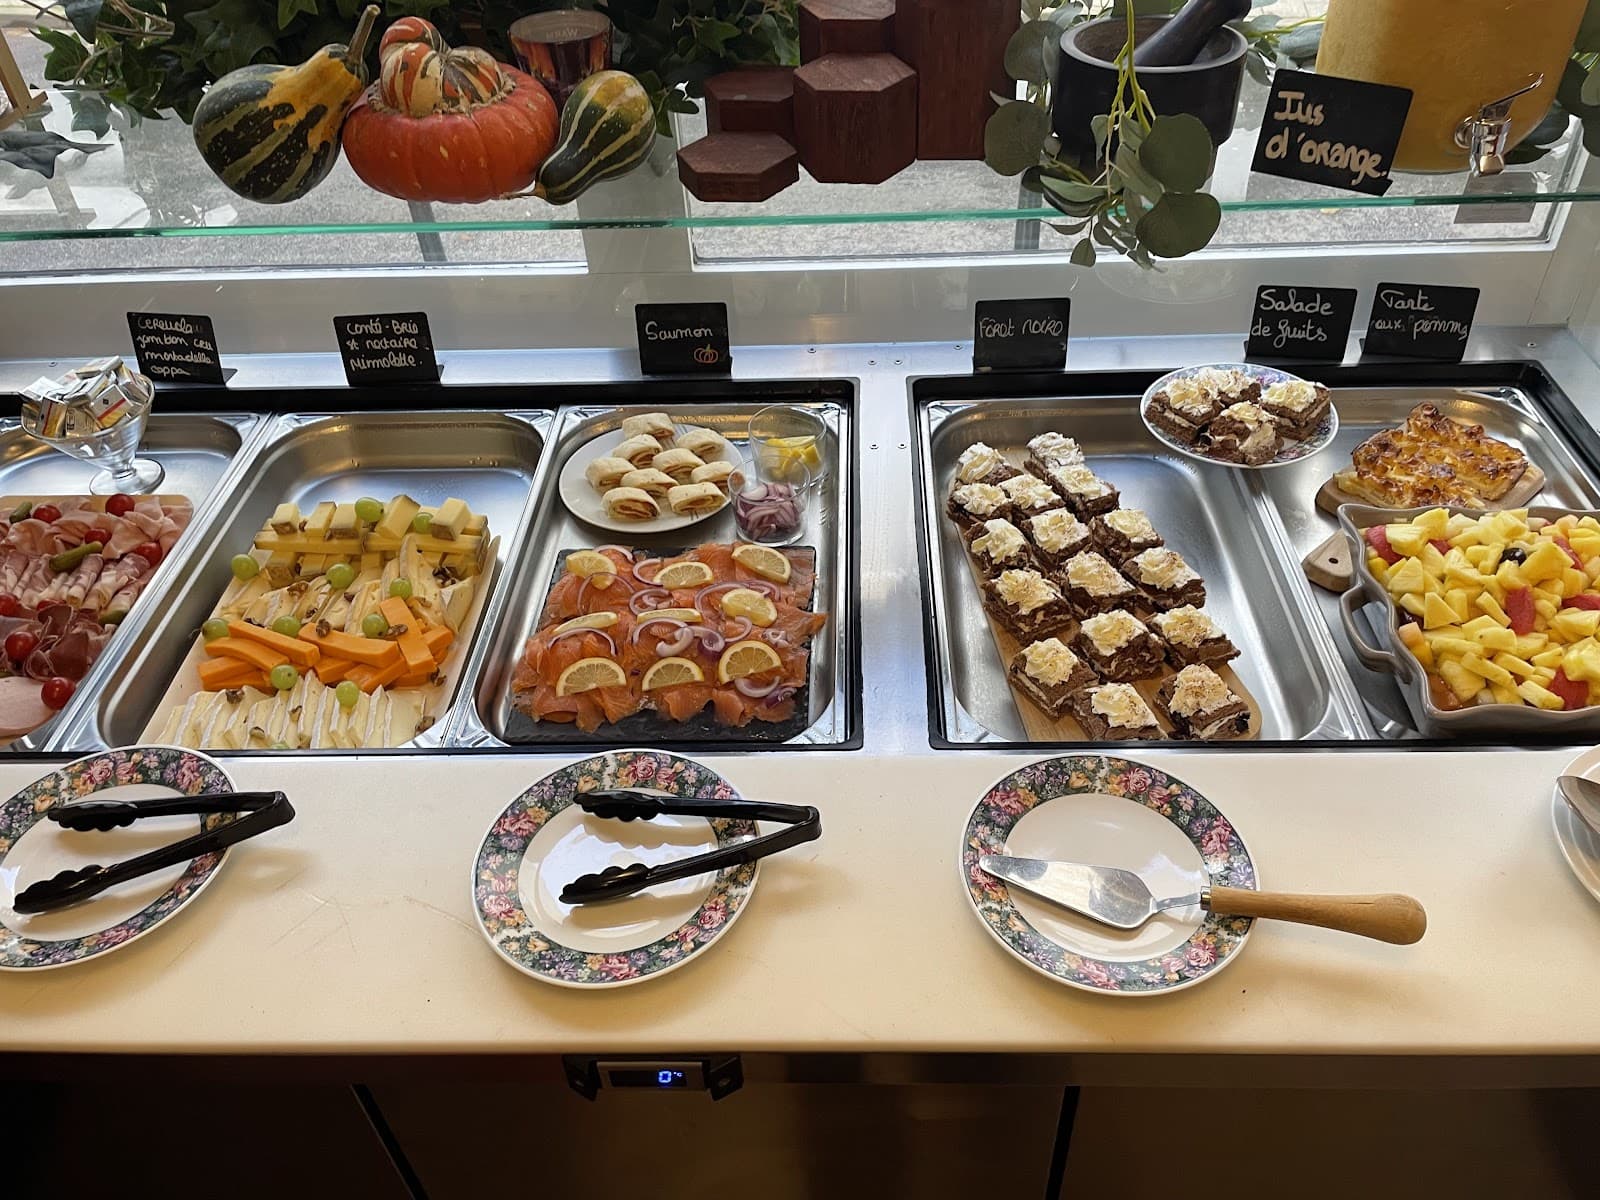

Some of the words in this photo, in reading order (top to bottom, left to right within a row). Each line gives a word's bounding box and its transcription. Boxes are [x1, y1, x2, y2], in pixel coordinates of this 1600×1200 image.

[1273, 90, 1325, 126] Jus
[1260, 288, 1334, 316] Salade
[1380, 288, 1435, 312] Tarte
[645, 320, 713, 340] Saumon
[1251, 317, 1272, 337] de
[1273, 319, 1328, 349] fruits
[1374, 319, 1402, 330] aux
[150, 365, 192, 379] coppa
